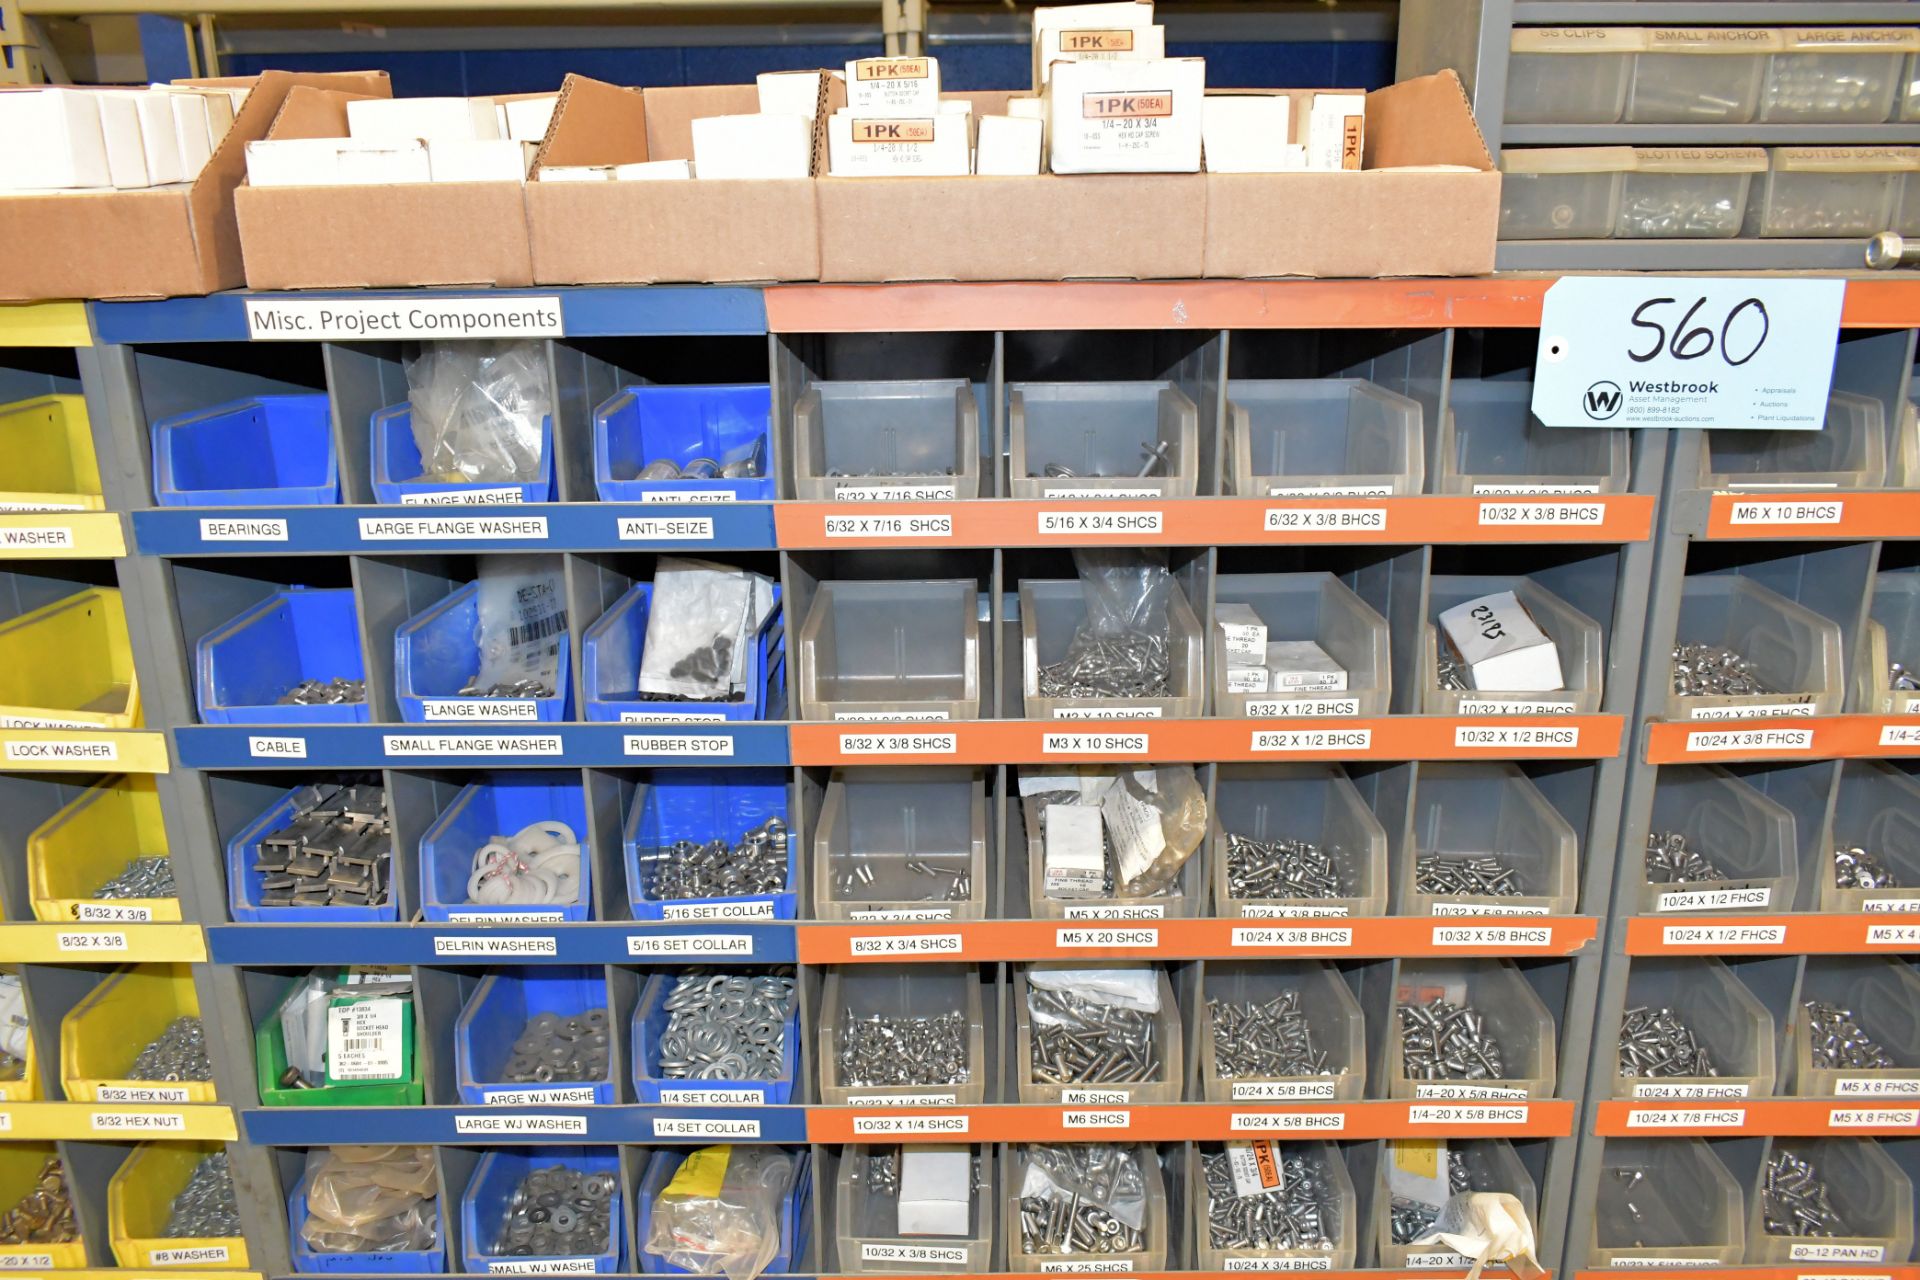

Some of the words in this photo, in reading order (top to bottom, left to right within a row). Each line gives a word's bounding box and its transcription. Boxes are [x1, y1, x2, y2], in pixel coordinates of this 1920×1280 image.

[1070, 36, 1103, 48] 1PK
[867, 64, 899, 77] 1PK
[1096, 98, 1135, 112] 1PK
[1138, 99, 1163, 110] (50EA)
[864, 125, 900, 138] 1PK
[1346, 125, 1357, 156] 1PK
[254, 311, 312, 330] Misc.
[320, 310, 401, 334] Project
[408, 309, 557, 333] Components
[1628, 296, 1769, 366] 560
[1629, 381, 1719, 393] Westbrook
[1653, 396, 1708, 404] Management
[1482, 508, 1516, 520] 10/32
[1521, 508, 1530, 519] X
[1535, 508, 1554, 520] 3/8
[1560, 508, 1598, 520] BHCS
[1738, 508, 1757, 519] M6
[1762, 508, 1771, 518] X
[1778, 507, 1792, 519] 10
[1796, 507, 1836, 518] BHCS
[1046, 517, 1074, 528] 5/16
[1079, 517, 1087, 528] X
[1093, 517, 1112, 528] 3/4
[1118, 516, 1156, 528] SHCS
[1270, 514, 1298, 525] 6/32
[1303, 514, 1311, 525] X
[1316, 514, 1336, 525] 3/8
[1342, 514, 1380, 525] BHCS
[209, 524, 280, 535] BEARINGS
[366, 522, 414, 534] LARGE
[419, 522, 475, 534] FLANGE
[479, 522, 541, 533] WASHER
[626, 522, 707, 534] ANTI-SEIZE
[827, 520, 854, 532] 6/32
[860, 520, 868, 532] X
[874, 520, 901, 532] 7/16
[910, 520, 949, 531] SHCS
[5, 532, 66, 544] WASHER
[1260, 735, 1286, 746] 8/32
[1291, 736, 1299, 745] X
[1306, 735, 1323, 745] 1/2
[1328, 734, 1365, 745] BHCS
[1462, 731, 1494, 742] 10/32
[1499, 732, 1507, 742] X
[1514, 732, 1530, 742] 1/2
[1536, 732, 1573, 742] BHCS
[1694, 735, 1728, 746] 10/24
[1731, 734, 1740, 744] X
[1744, 734, 1762, 744] 3/8
[1767, 733, 1804, 744] FHCS
[256, 741, 300, 752] CABLE
[391, 740, 435, 750] SMALL
[439, 740, 493, 750] FLANGE
[497, 740, 556, 750] WASHER
[631, 740, 686, 750] RUBBER
[692, 740, 728, 751] STOP
[845, 739, 872, 749] 8/32
[877, 739, 884, 748] X
[890, 738, 908, 749] 3/8
[913, 738, 951, 749] SHCS
[1050, 738, 1068, 748] M3
[1073, 738, 1080, 748] X
[1087, 738, 1101, 749] 10
[1106, 738, 1142, 749] SHCS
[12, 746, 48, 756] LOCK
[52, 746, 110, 756] WASHER
[1064, 933, 1081, 942] M5
[1086, 933, 1093, 942] X
[1098, 933, 1112, 943] 20
[1117, 933, 1152, 942] SHCS
[1240, 932, 1272, 942] 10/24
[1276, 932, 1284, 942] X
[1288, 932, 1307, 942] 3/8
[1312, 932, 1346, 942] BHCS
[1440, 931, 1470, 941] 10/32
[1475, 931, 1482, 940] X
[1487, 931, 1506, 941] 5/8
[1510, 931, 1546, 941] BHCS
[1670, 930, 1701, 940] 10/24
[1705, 930, 1713, 940] X
[1720, 930, 1736, 940] 1/2
[1741, 930, 1777, 940] FHCS
[62, 936, 88, 946] 8/32
[92, 937, 100, 946] X
[104, 936, 122, 946] 3/8
[437, 941, 484, 951] DELRIN
[488, 941, 555, 951] WASHERS
[634, 940, 660, 950] 5/16
[664, 940, 688, 950] SET
[693, 940, 746, 950] COLLAR
[855, 941, 881, 951] 8/32
[886, 941, 894, 950] X
[898, 940, 916, 950] 3/4
[921, 939, 957, 949] SHCS
[1068, 1115, 1086, 1124] M6
[1090, 1115, 1124, 1124] SHCS
[1413, 1110, 1450, 1119] 1/4-20
[1455, 1110, 1462, 1119] X
[1466, 1110, 1484, 1119] 5/8
[1488, 1110, 1522, 1119] BHCS
[1637, 1114, 1666, 1123] 10/24
[1670, 1114, 1678, 1122] X
[1684, 1114, 1700, 1122] 7/8
[1704, 1113, 1738, 1122] FHCS
[1834, 1113, 1851, 1122] M5
[1855, 1114, 1863, 1122] X
[1866, 1113, 1874, 1122] 8
[1877, 1113, 1912, 1122] FHCS
[97, 1116, 121, 1126] 8/32
[126, 1117, 150, 1126] HEX
[154, 1117, 178, 1126] NUT
[458, 1120, 500, 1129] LARGE
[504, 1120, 522, 1129] WJ
[526, 1120, 581, 1129] WASHER
[896, 1121, 902, 1129] X
[908, 1120, 924, 1129] 1/4
[928, 1120, 963, 1129] SHCS
[1238, 1118, 1268, 1126] 10/24
[1272, 1118, 1279, 1126] X
[1284, 1117, 1301, 1126] 5/8
[1306, 1117, 1339, 1126] BHCS
[658, 1123, 673, 1131] 1/4
[678, 1123, 701, 1132] SET
[706, 1123, 755, 1133] COLLAR
[156, 1252, 169, 1261] #8
[172, 1250, 224, 1260] WASHER
[865, 1248, 895, 1257] 10/32
[910, 1250, 926, 1258] 3/8
[930, 1250, 963, 1260] SHCS
[1794, 1248, 1829, 1256] 60-12
[1832, 1249, 1857, 1257] PAN
[1860, 1250, 1879, 1258] HD
[1229, 1262, 1258, 1270] 10/24
[1262, 1262, 1269, 1270] X
[1273, 1262, 1290, 1270] 3/4
[1294, 1261, 1328, 1270] BHCS
